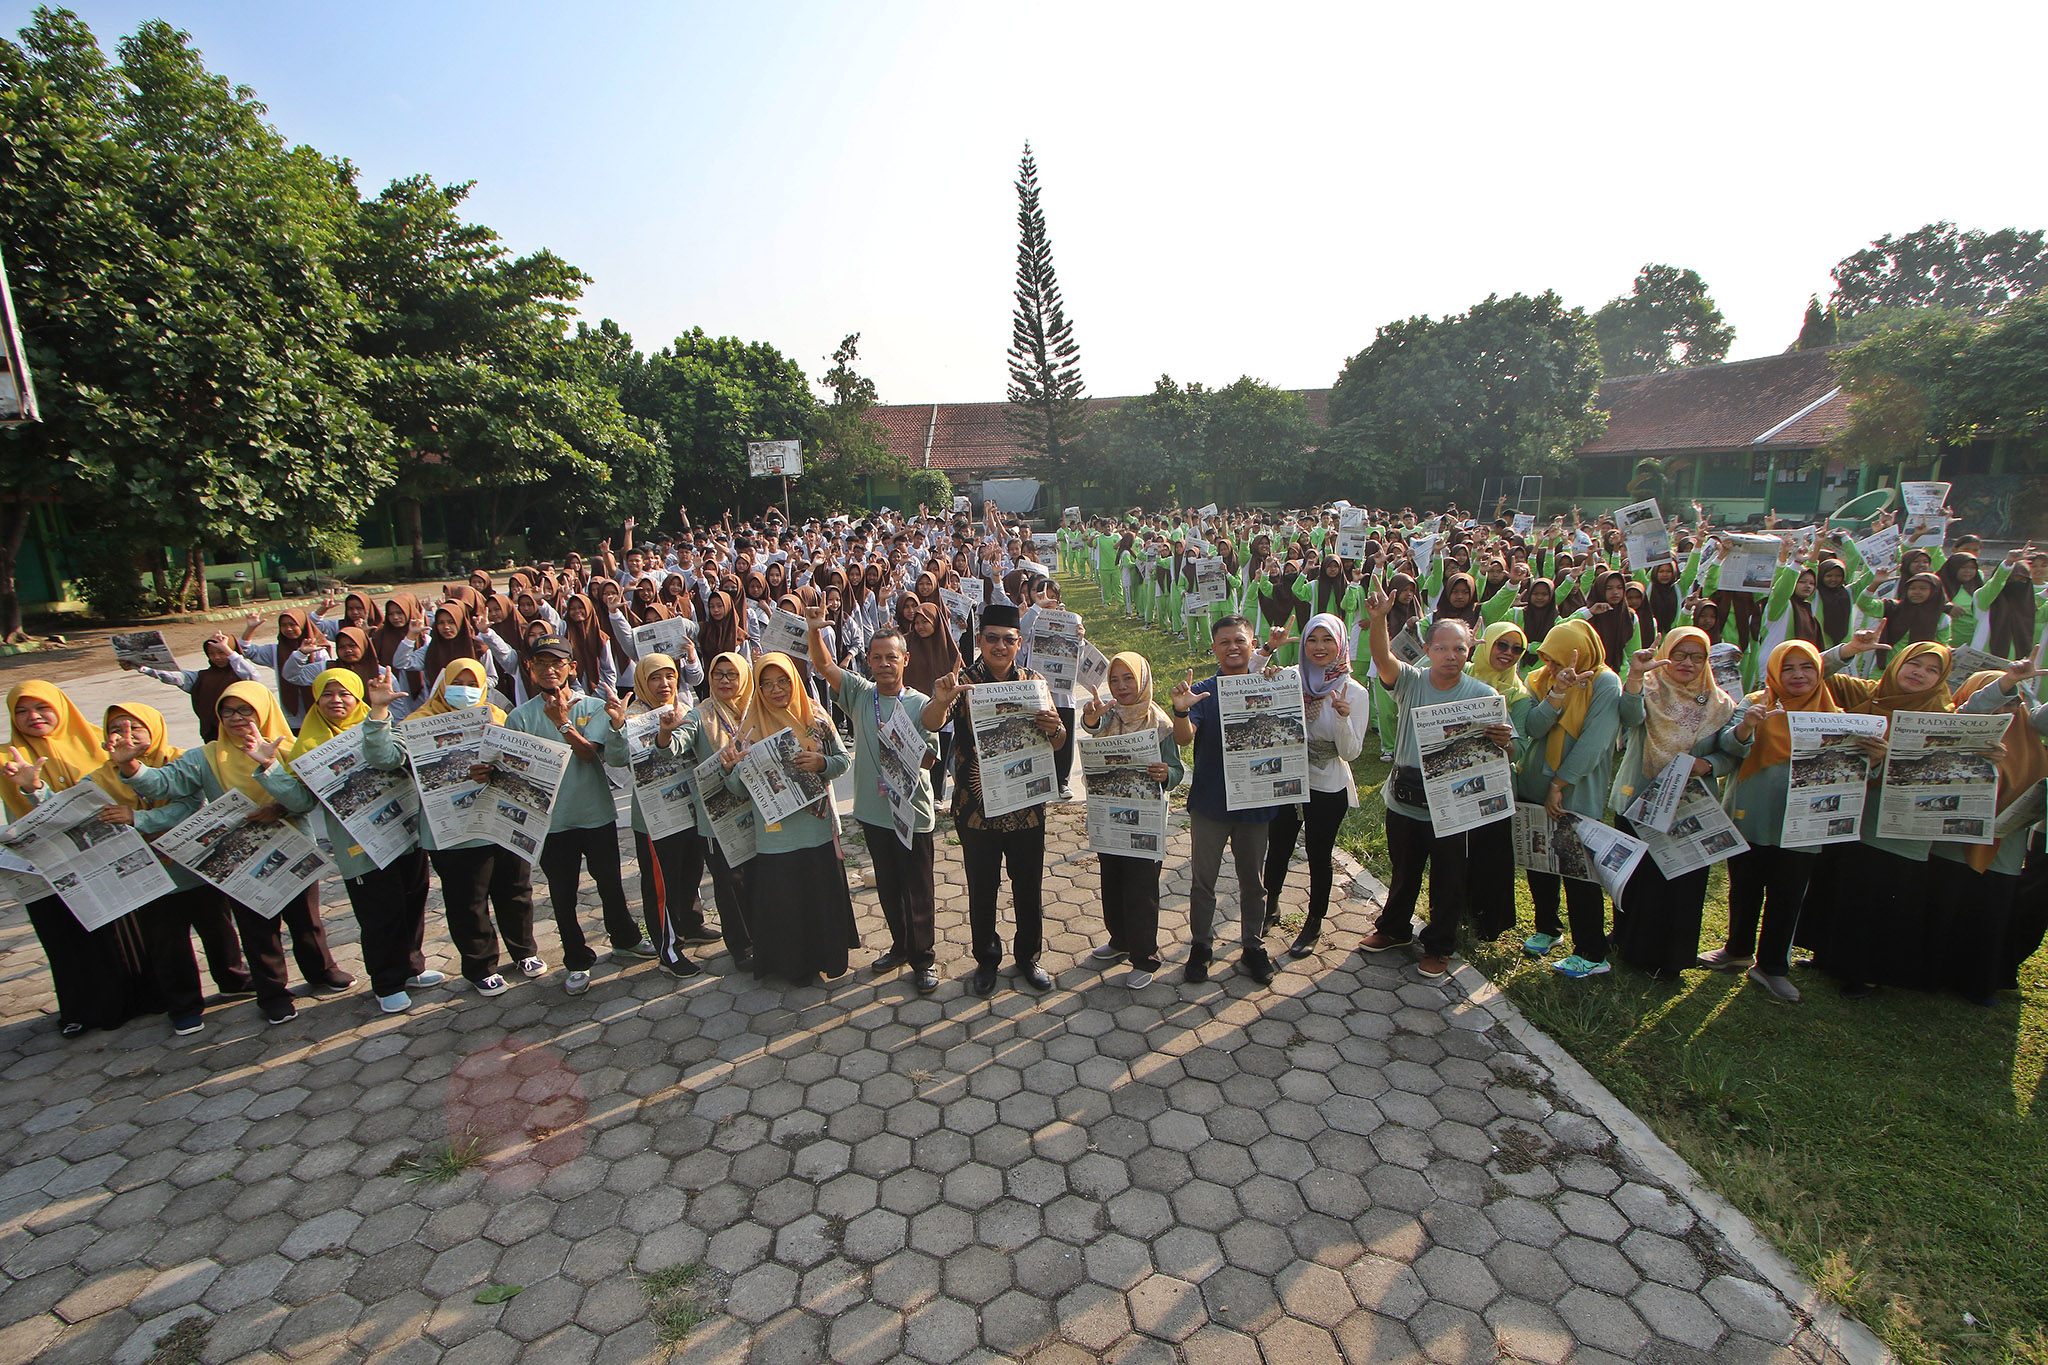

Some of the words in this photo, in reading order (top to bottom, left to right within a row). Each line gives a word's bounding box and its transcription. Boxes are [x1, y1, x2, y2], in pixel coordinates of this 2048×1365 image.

[1236, 678, 1264, 686] RADAR
[1264, 674, 1284, 684] SOLO
[986, 685, 1014, 694] RADAR
[1431, 706, 1461, 717] RADAR
[1463, 702, 1486, 711] SOLO
[421, 716, 450, 728] RADAR
[452, 712, 474, 721] SOLO
[1809, 716, 1844, 724] RADAR
[1846, 718, 1869, 726] SOLO
[1917, 717, 1956, 726] RADAR
[1960, 719, 1988, 727] SOLO
[310, 743, 338, 760] RADAR
[337, 731, 356, 745] SOLO
[500, 733, 528, 747] RADAR
[530, 742, 551, 754] SOLO
[1124, 736, 1144, 745] SOLO
[742, 767, 754, 783] SOLO
[753, 784, 769, 809] RADAR
[173, 815, 204, 838] RADAR
[204, 803, 226, 818] SOLO
